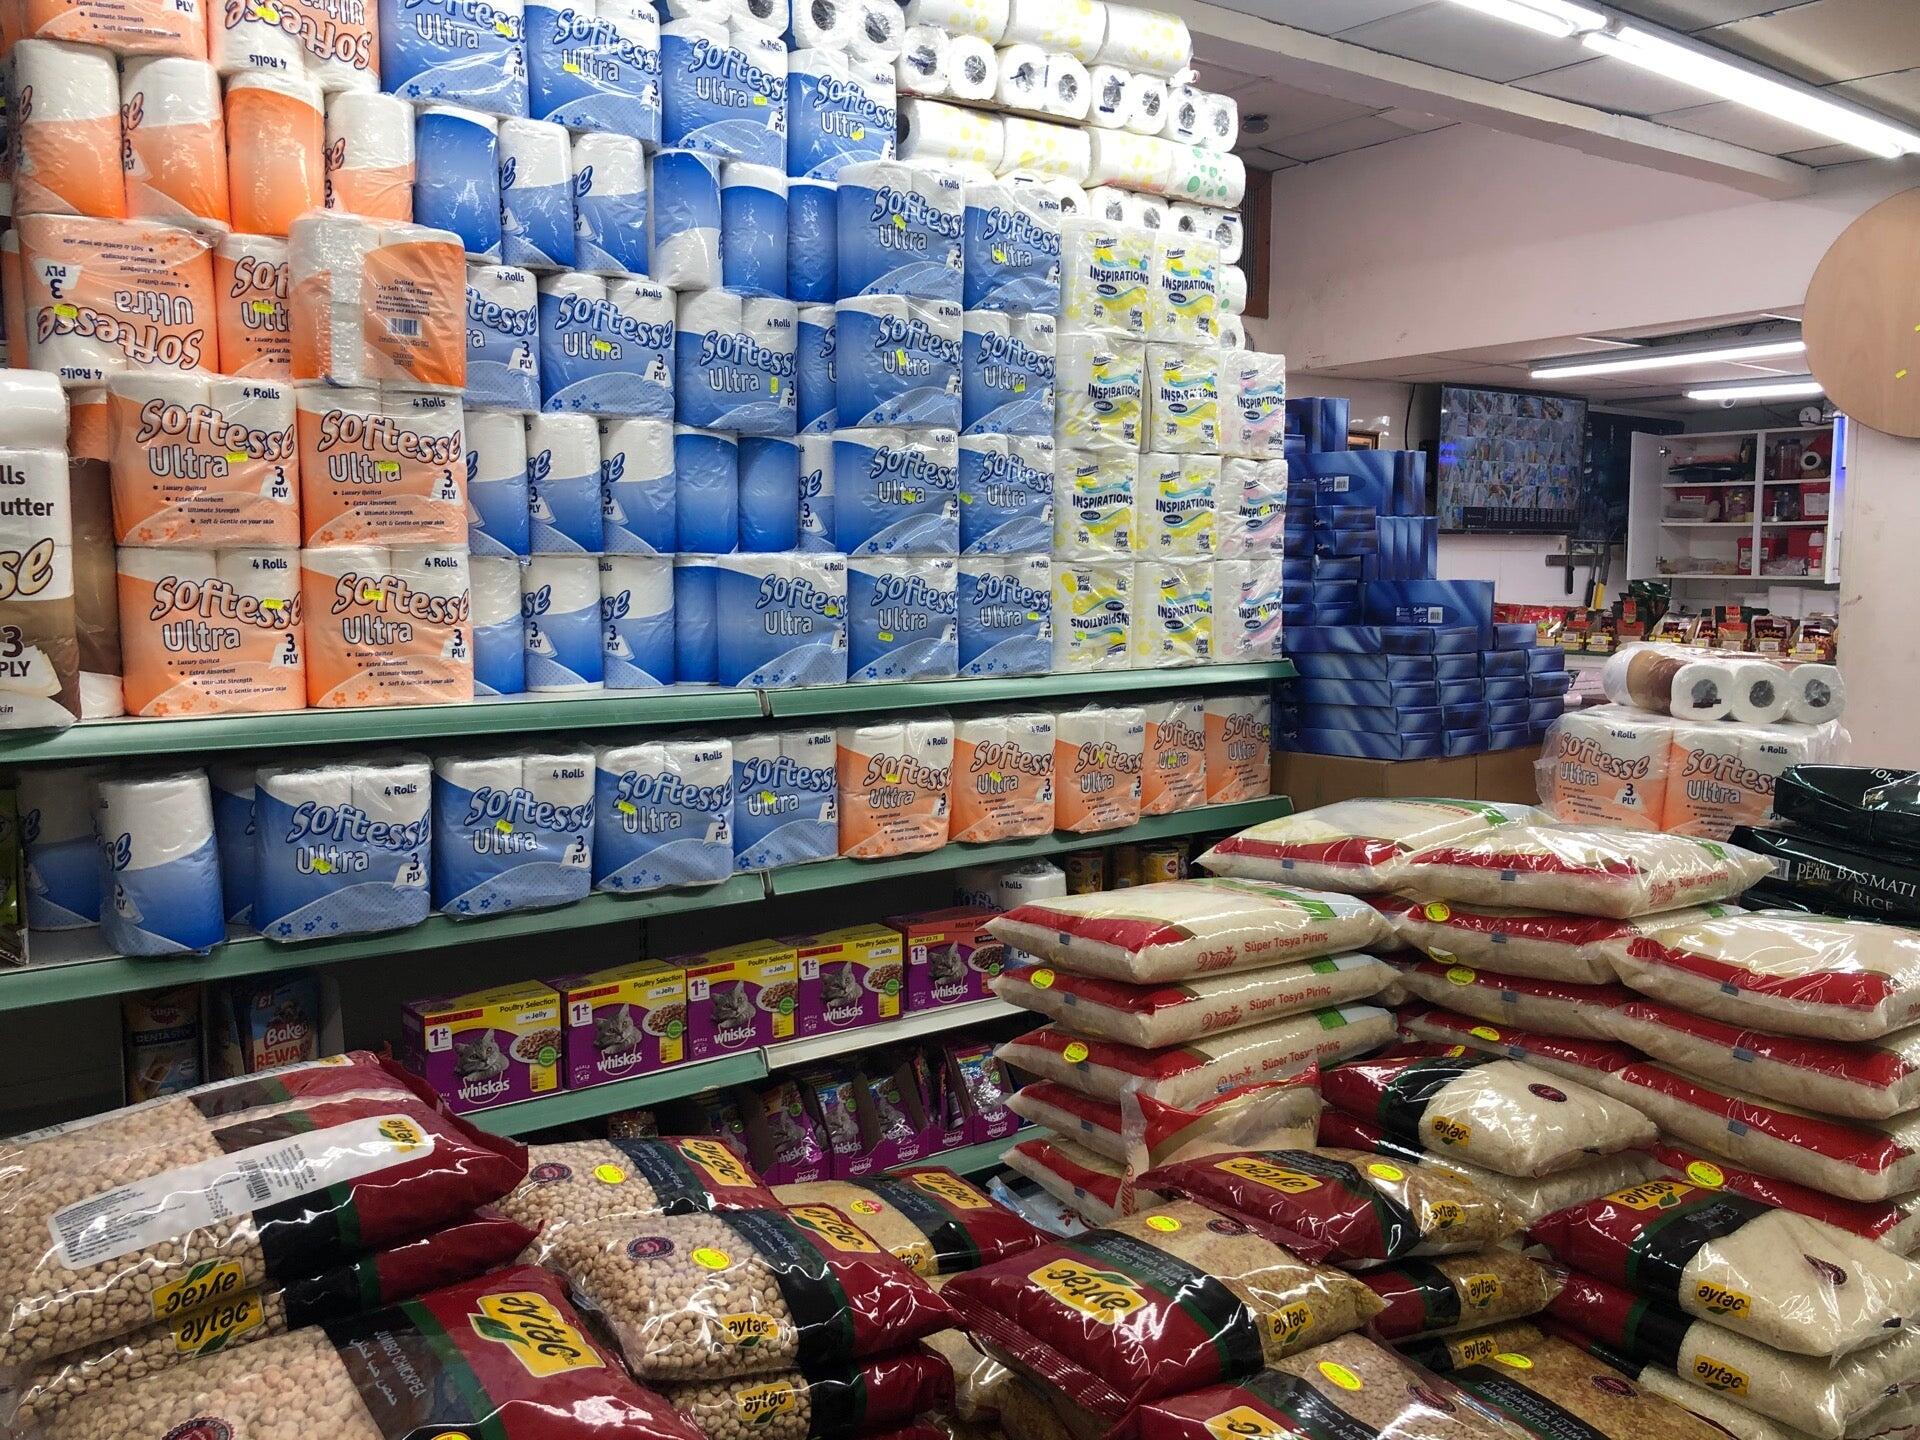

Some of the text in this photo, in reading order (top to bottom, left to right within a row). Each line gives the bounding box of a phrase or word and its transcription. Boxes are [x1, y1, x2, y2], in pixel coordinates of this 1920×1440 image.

[176, 0, 194, 12] PLY
[416, 14, 479, 49] Ultra
[696, 76, 748, 107] Ultra
[1090, 265, 1149, 285] INSPIRATIONS
[1161, 275, 1216, 294] INSPIRATIONS
[634, 288, 662, 299] 4 Rolls
[115, 290, 194, 326] Ultra
[554, 292, 674, 350] Softesse
[519, 358, 533, 370] PLY
[653, 370, 667, 382] PLY
[709, 366, 760, 393] Ultra
[1088, 382, 1140, 400] INSPIRATIONS
[136, 398, 294, 461] Softesse
[317, 409, 462, 466] Softesse
[149, 444, 229, 479] Ultra
[1076, 465, 1099, 477] Freedom
[1159, 471, 1181, 483] Freedom
[271, 486, 289, 498] PLY
[986, 483, 1028, 507] Ultra
[1072, 493, 1133, 510] INSPIRATIONS
[0, 499, 55, 517] utter
[215, 506, 241, 515] Strength
[1155, 498, 1215, 514] INSPIRATIONS
[200, 517, 213, 525] Soft
[220, 517, 238, 525] Gentle
[248, 518, 262, 527] your
[263, 517, 275, 525] skin
[396, 519, 412, 528] Gentle
[421, 520, 433, 529] your
[151, 576, 303, 630] Softesse
[331, 572, 470, 625] Softesse
[879, 608, 929, 633] Ultra
[980, 605, 1023, 628] Ultra
[1070, 611, 1130, 628] INSPIRATIONS
[1157, 603, 1213, 619] INSPIRATIONS
[162, 619, 240, 653] Ultra
[342, 613, 413, 647] Ultra
[529, 638, 542, 648] PLY
[606, 641, 620, 651] PLY
[214, 688, 227, 696] Soft
[261, 687, 274, 696] your
[228, 676, 253, 685] Strength
[694, 751, 724, 763] 4 Rolls
[1559, 732, 1651, 779] Softesse
[552, 769, 585, 780] 4 Rolls
[1081, 774, 1115, 794] Ultra
[1560, 760, 1599, 787] Ultra
[614, 771, 734, 811] Softesse
[1621, 797, 1637, 806] PLY
[1687, 780, 1741, 805] Ultra
[464, 786, 595, 833] Softesse
[286, 800, 432, 851] Softesse
[572, 853, 587, 865] PLY
[1796, 862, 1832, 882] PEARL
[1837, 865, 1918, 898] BASMATI
[1853, 889, 1896, 912] RICE
[855, 936, 900, 950] Poultry Selection
[1244, 931, 1329, 953] Süper Tosya Pirinç
[748, 952, 794, 967] Poultry Selection
[774, 965, 787, 974] Jelly
[633, 973, 683, 990] Poultry Selection
[661, 986, 675, 996] Jelly
[930, 984, 969, 1000] whiskas
[500, 998, 557, 1014] Poultry Selection
[1250, 985, 1332, 1011] Süper Tosya Pirinç
[532, 1009, 547, 1020] Jelly
[822, 1004, 864, 1023] whiskas
[713, 1025, 756, 1045] whiskas
[596, 1050, 643, 1072] whiskas
[457, 1079, 511, 1101] whiskas
[1433, 1119, 1468, 1142] aytac
[692, 1139, 742, 1182] aytac
[1231, 1160, 1310, 1191] aytac
[1617, 1180, 1675, 1206] aytac
[804, 1208, 865, 1250] aytac
[166, 1270, 238, 1314] aytac
[1045, 1268, 1133, 1313] aytac
[1469, 1278, 1498, 1298] aytac
[1697, 1284, 1746, 1312] aytac
[180, 1301, 251, 1344] aytac
[496, 1295, 582, 1358] aytac
[728, 1318, 771, 1339] aytac
[1272, 1309, 1310, 1336] aytac
[1463, 1337, 1495, 1361] aytac
[391, 1353, 428, 1399] CHICKPEA
[1696, 1360, 1744, 1390] aytac
[743, 1390, 789, 1413] aytac
